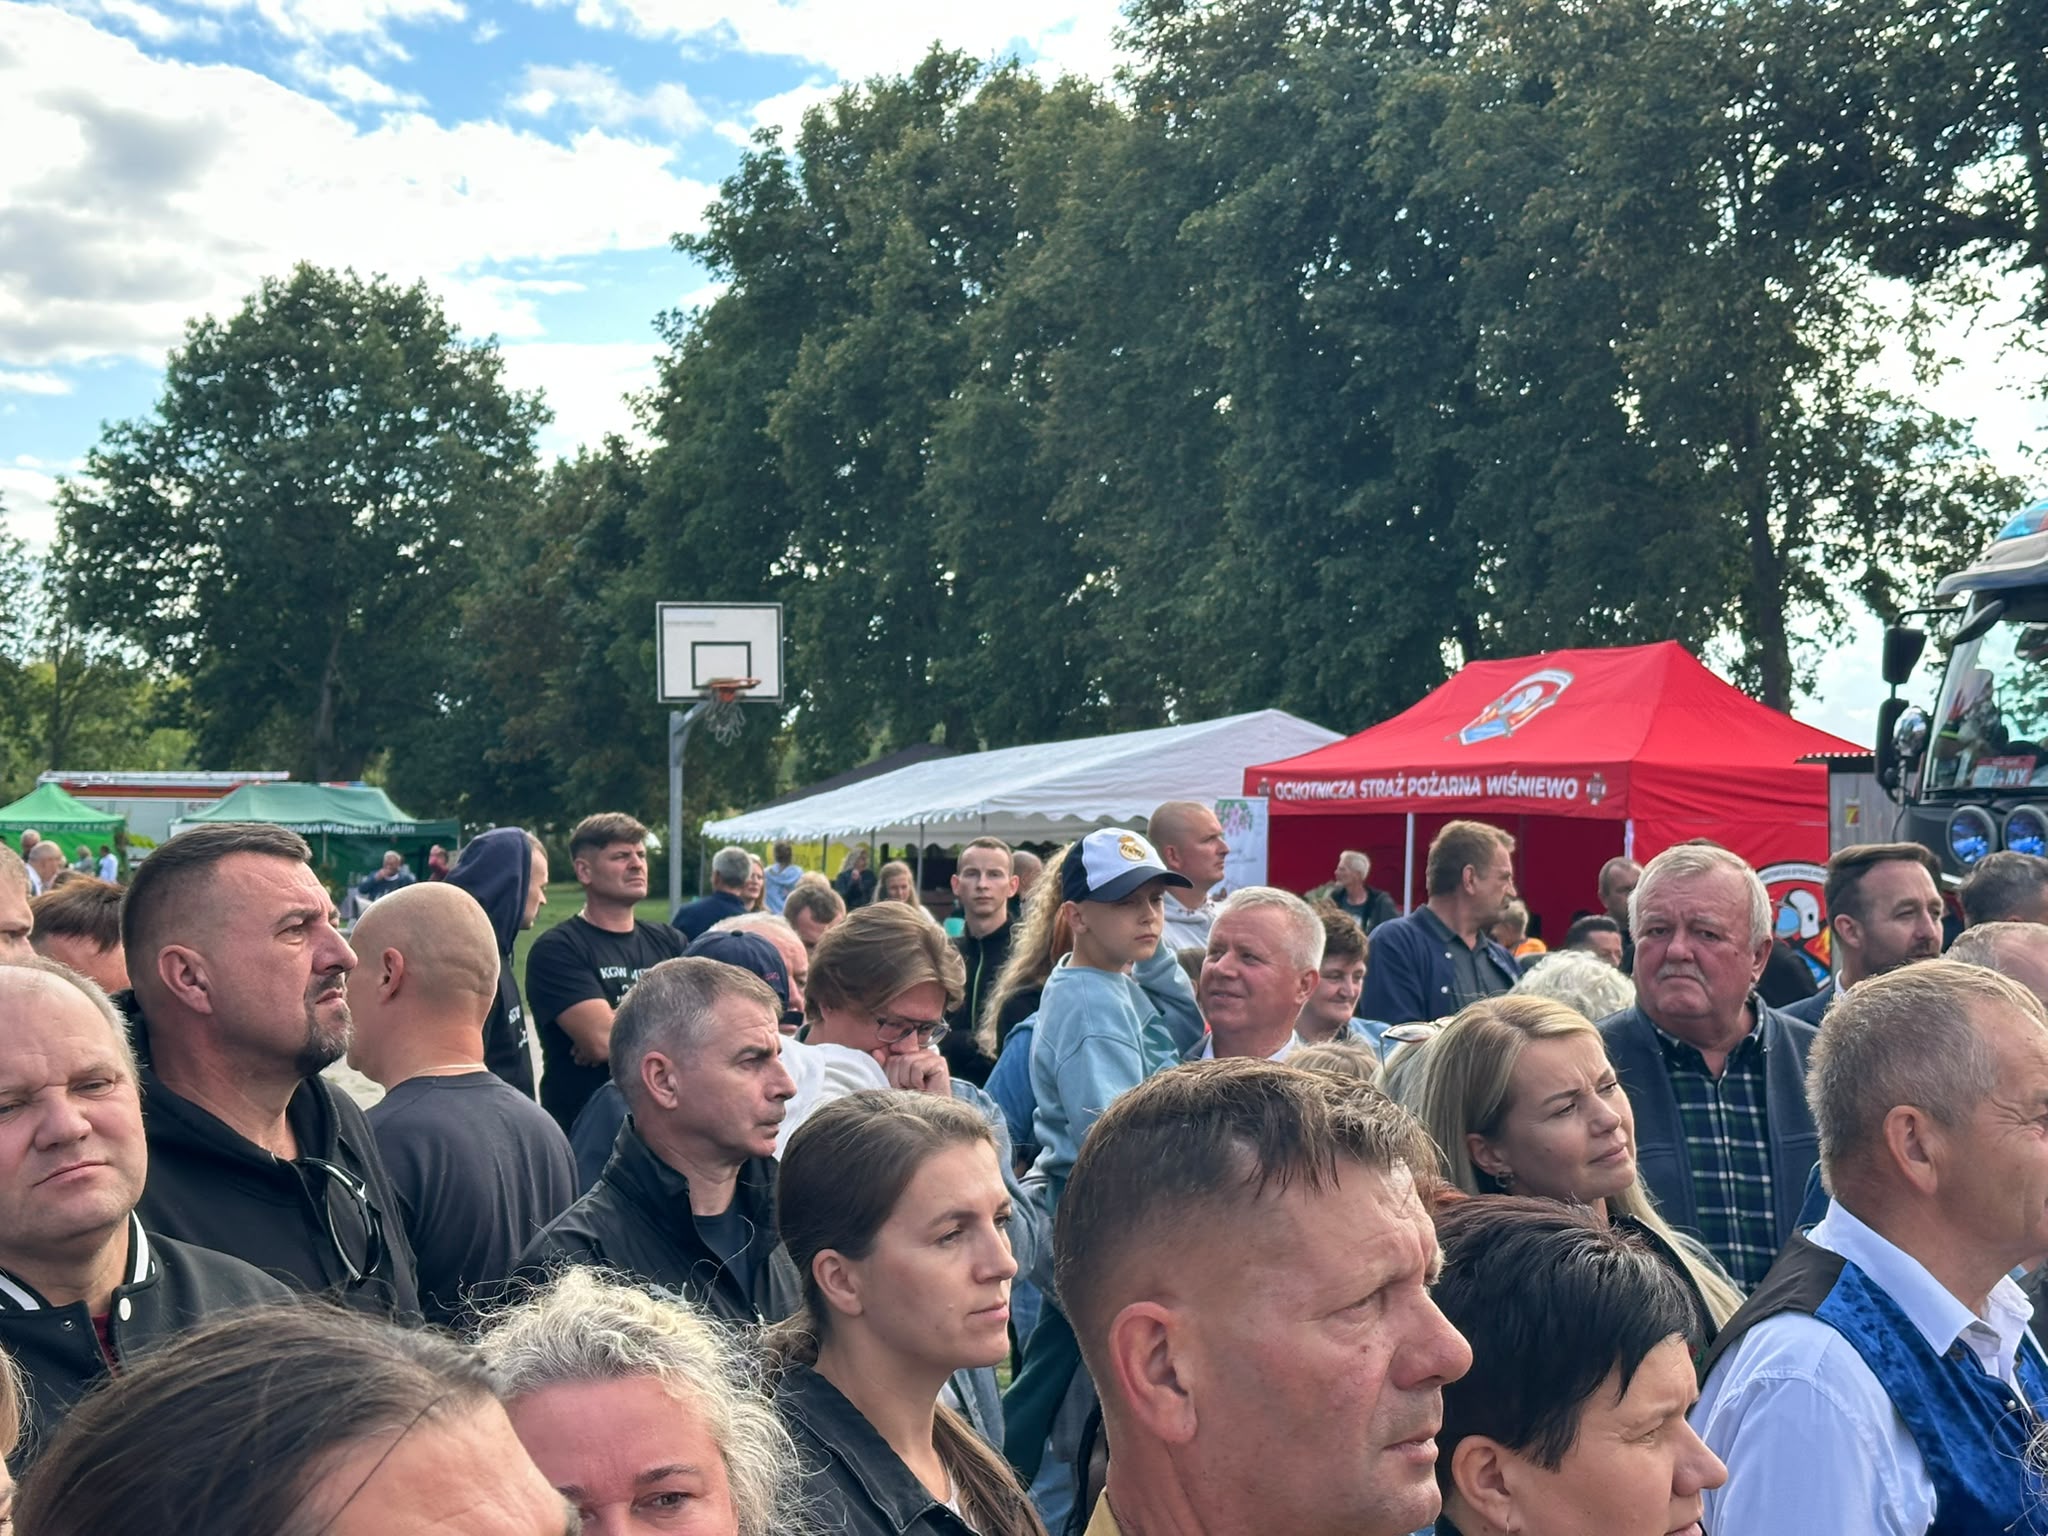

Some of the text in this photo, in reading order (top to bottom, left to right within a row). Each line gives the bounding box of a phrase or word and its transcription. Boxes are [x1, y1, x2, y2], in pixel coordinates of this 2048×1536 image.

[1275, 769, 1578, 801] OCHOTNICZA STRAŻ POŻARNA WIŚNIEWO
[380, 823, 416, 836] Kuklin
[600, 966, 627, 980] KGW
